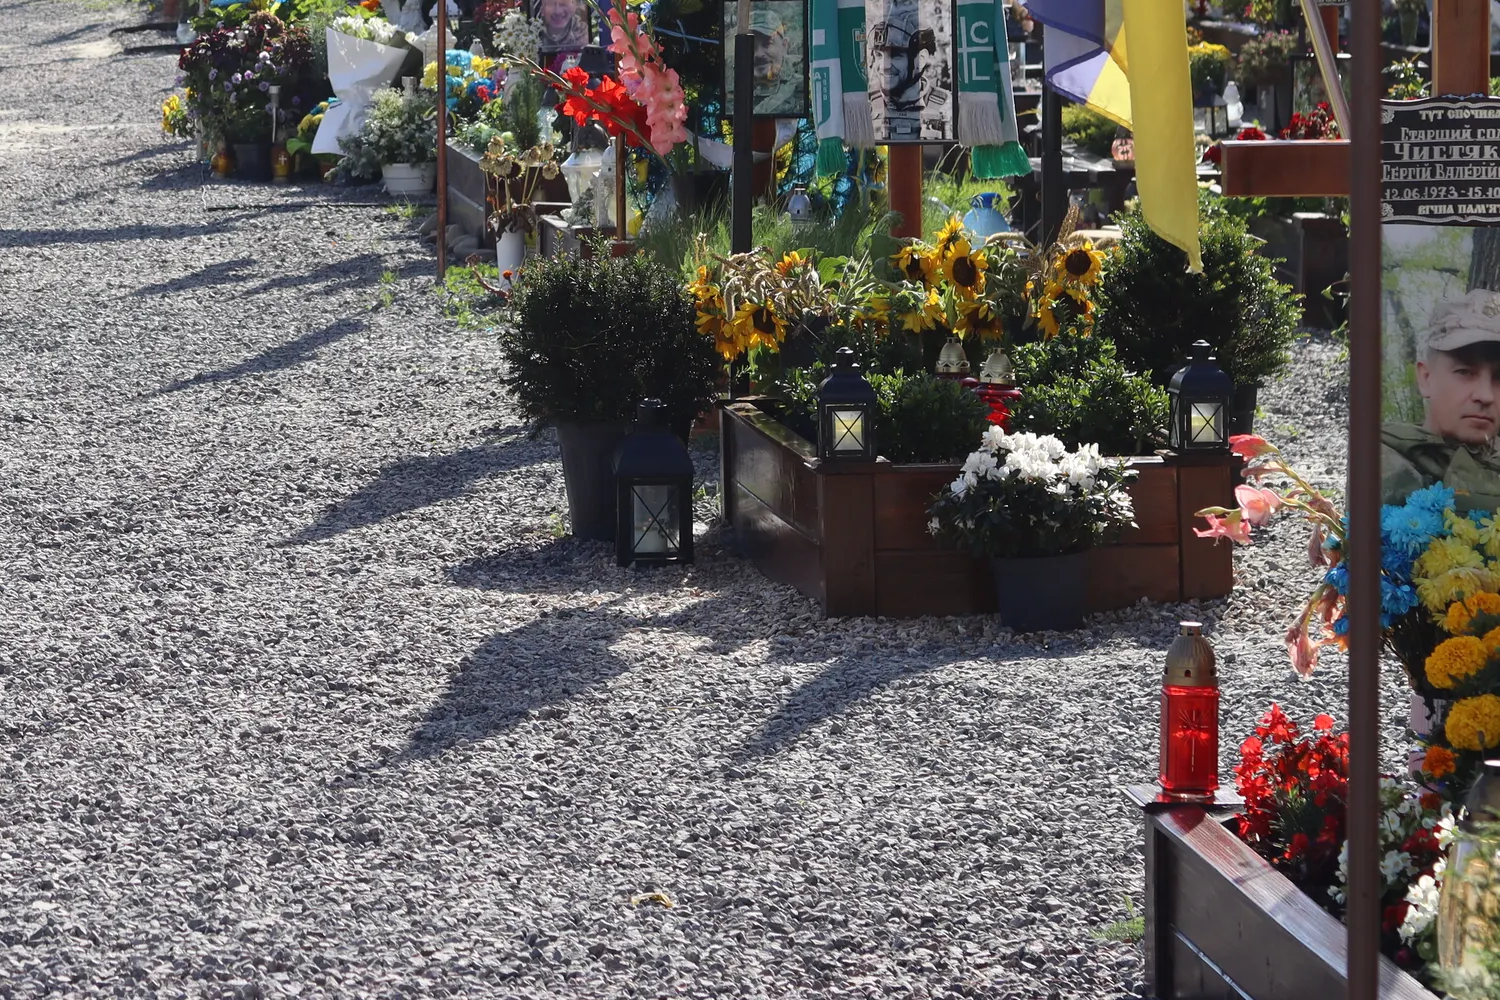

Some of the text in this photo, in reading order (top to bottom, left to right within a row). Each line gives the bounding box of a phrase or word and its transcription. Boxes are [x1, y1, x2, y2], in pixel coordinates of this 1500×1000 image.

[1419, 109, 1445, 122] ТУТ
[1401, 124, 1472, 141] СТАРШИЙ
[1393, 143, 1500, 160] ЧИСТЯК
[1382, 163, 1432, 180] СЕРГІЙ
[1417, 203, 1500, 215] ВІЧНА ПАМ'Я
